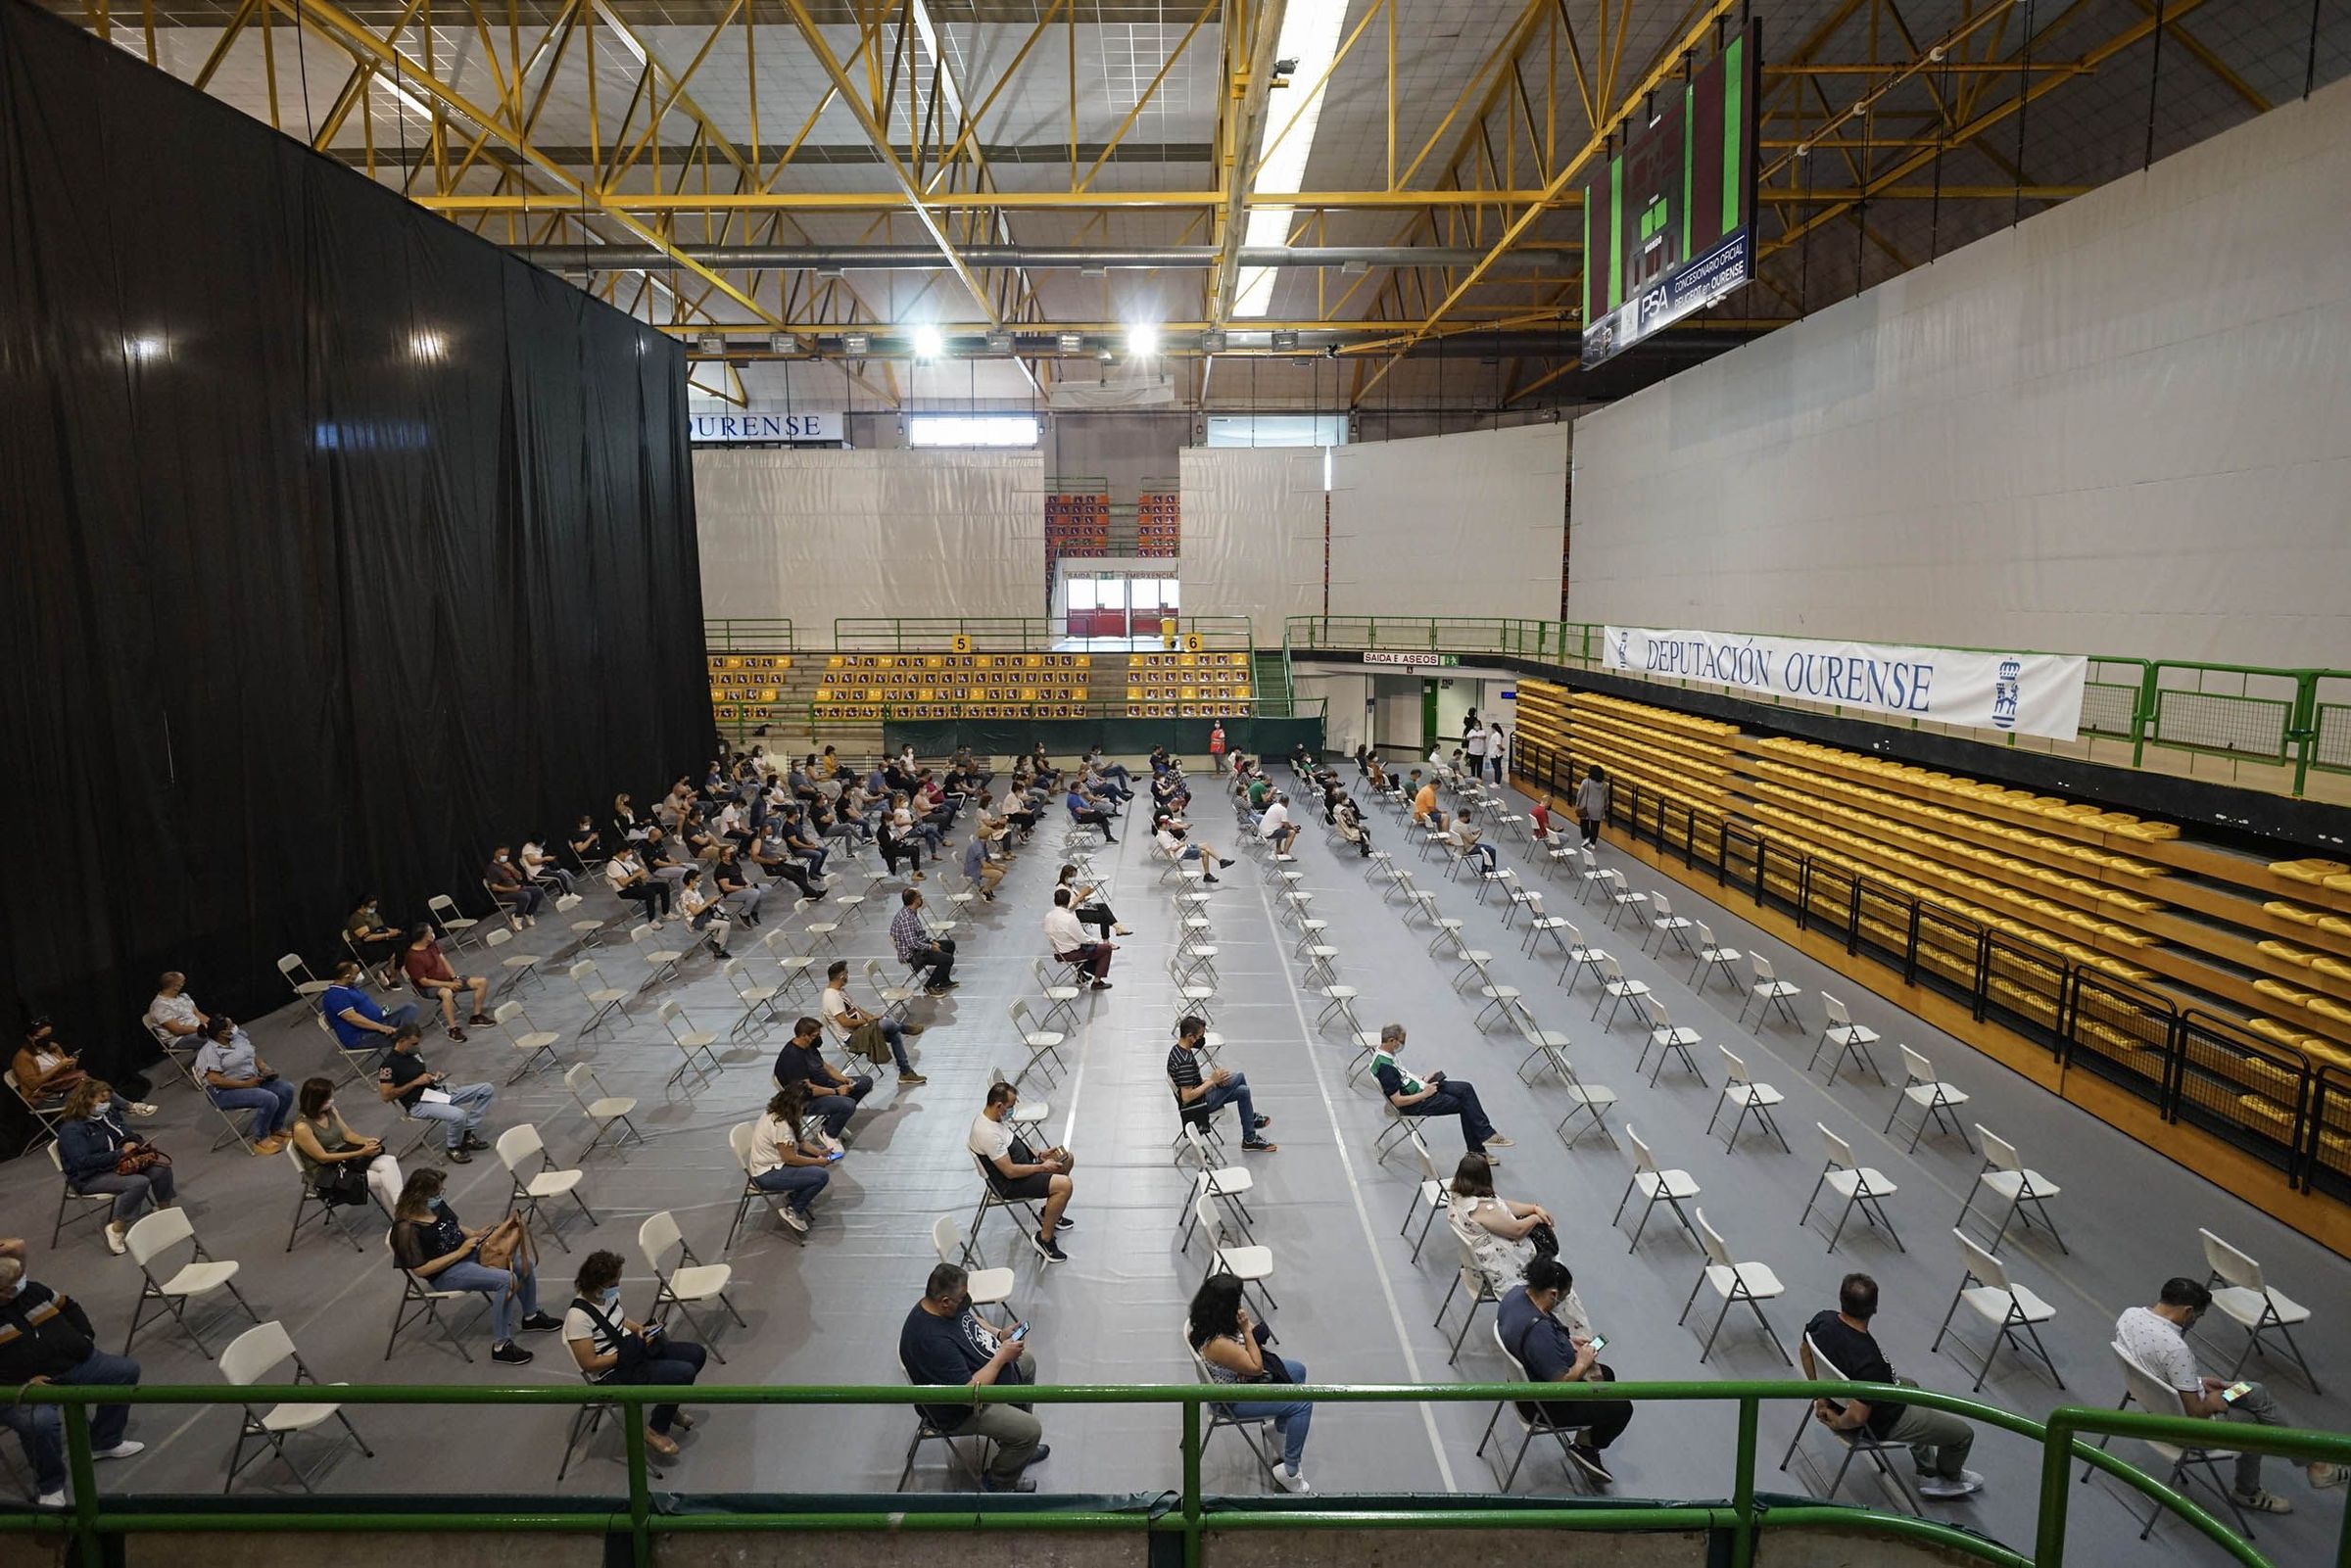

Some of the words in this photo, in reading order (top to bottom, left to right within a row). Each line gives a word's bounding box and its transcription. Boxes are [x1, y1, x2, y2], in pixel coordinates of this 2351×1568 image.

[1674, 258, 1720, 293] CONCESIONARIO
[1720, 242, 1744, 265] OFICIAL
[1710, 260, 1745, 289] OURENSE
[1641, 285, 1668, 323] PSA
[957, 638, 966, 650] 5
[1189, 637, 1198, 649] 6
[1393, 654, 1399, 663] E
[1402, 655, 1437, 664] ASEOS
[1646, 637, 1773, 687] DEPUTACIÓN
[1785, 652, 1934, 712] OURENSE
